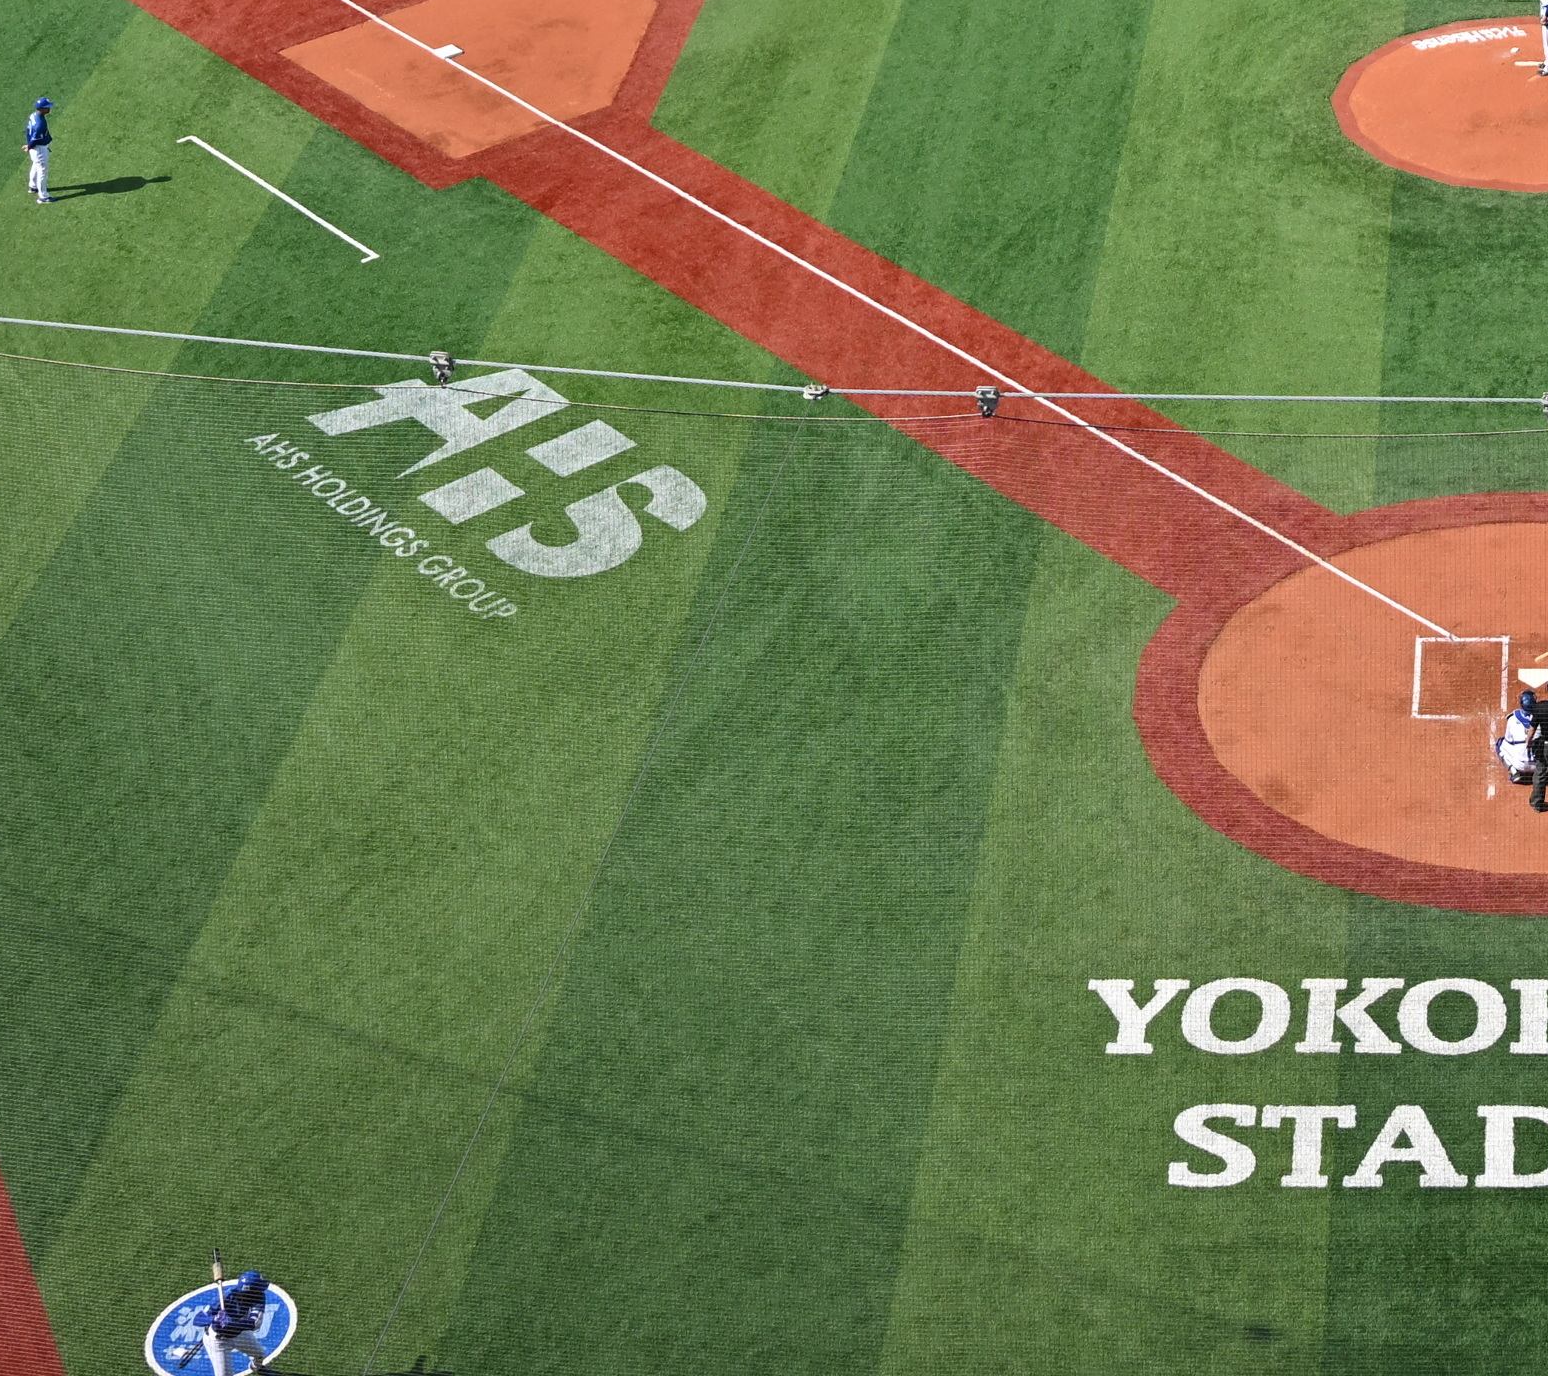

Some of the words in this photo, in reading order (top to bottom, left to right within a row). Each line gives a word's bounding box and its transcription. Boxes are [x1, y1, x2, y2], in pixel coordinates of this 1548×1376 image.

[244, 432, 311, 471] AHS
[298, 464, 430, 558] HOLDINGS
[417, 554, 518, 620] GROUP
